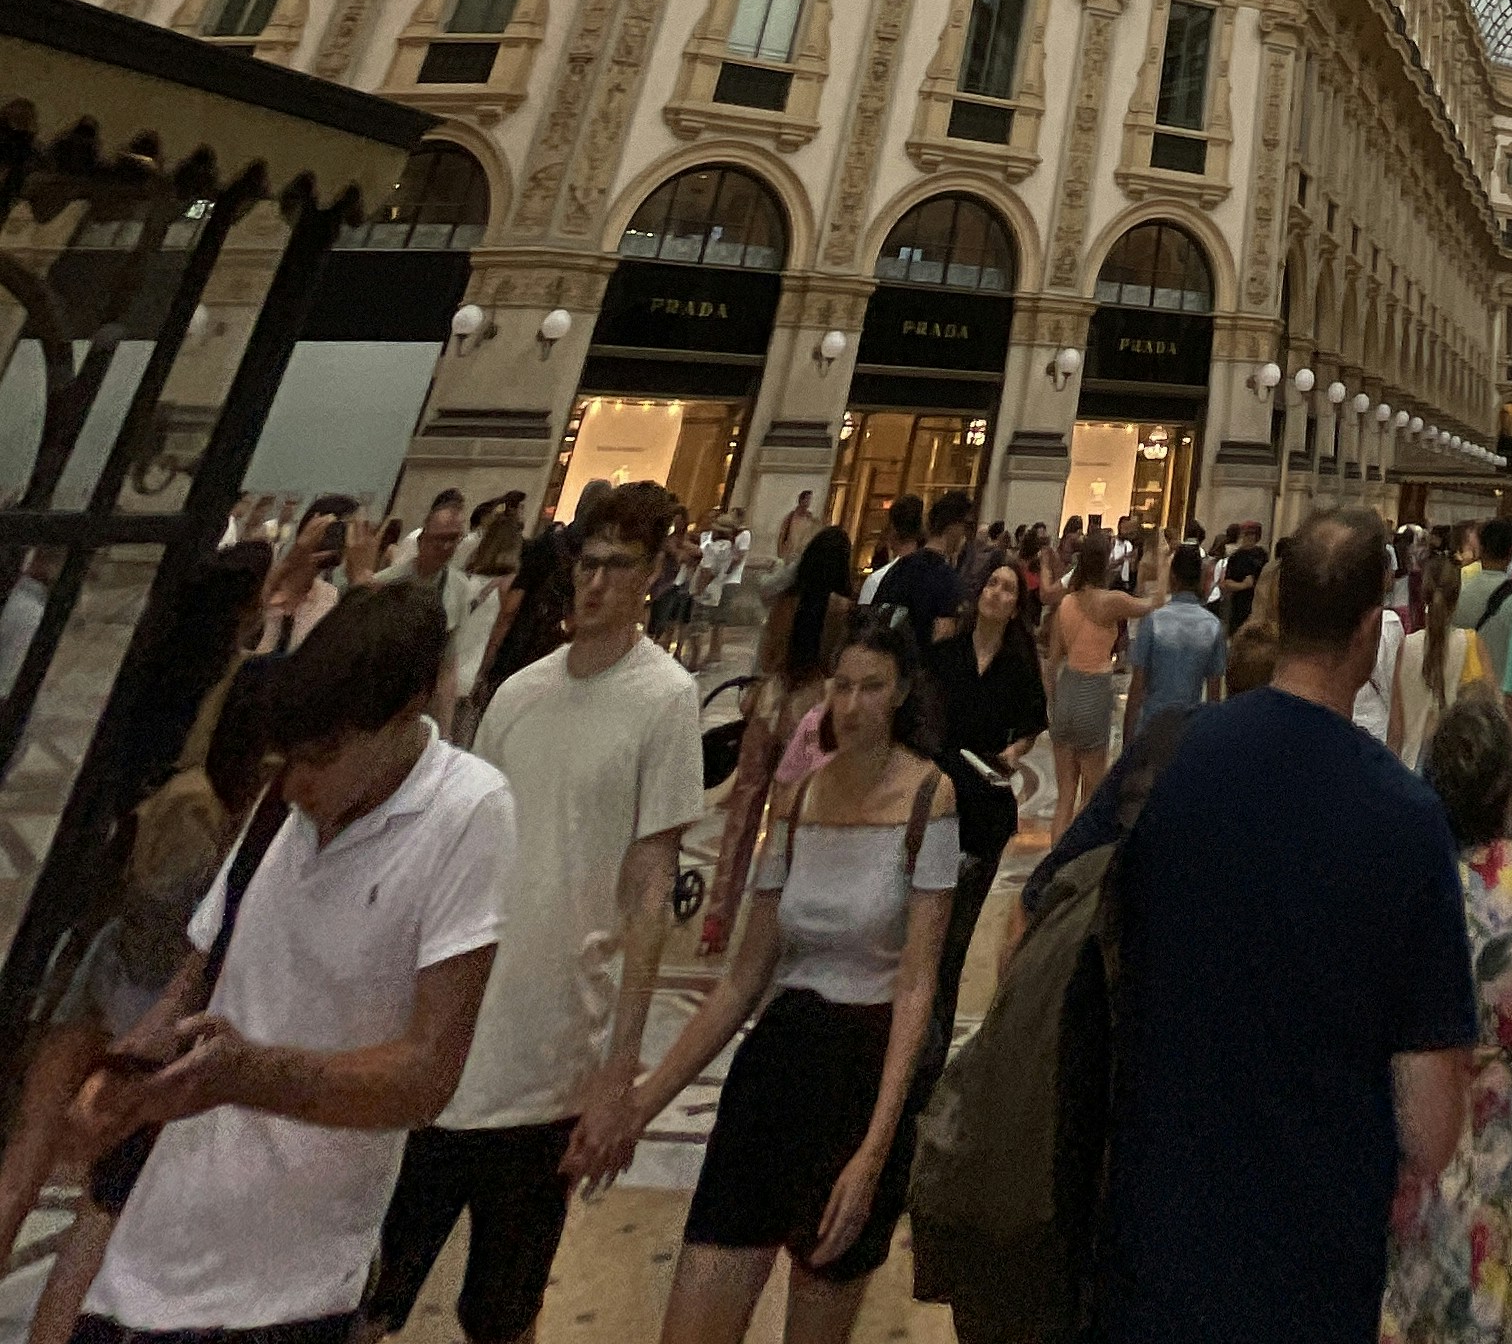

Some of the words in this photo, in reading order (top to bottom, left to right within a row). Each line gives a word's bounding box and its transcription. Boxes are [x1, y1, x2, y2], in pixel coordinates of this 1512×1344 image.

[650, 298, 728, 318] PRADA
[902, 320, 968, 339] PRADA
[1120, 338, 1177, 355] PRADA
